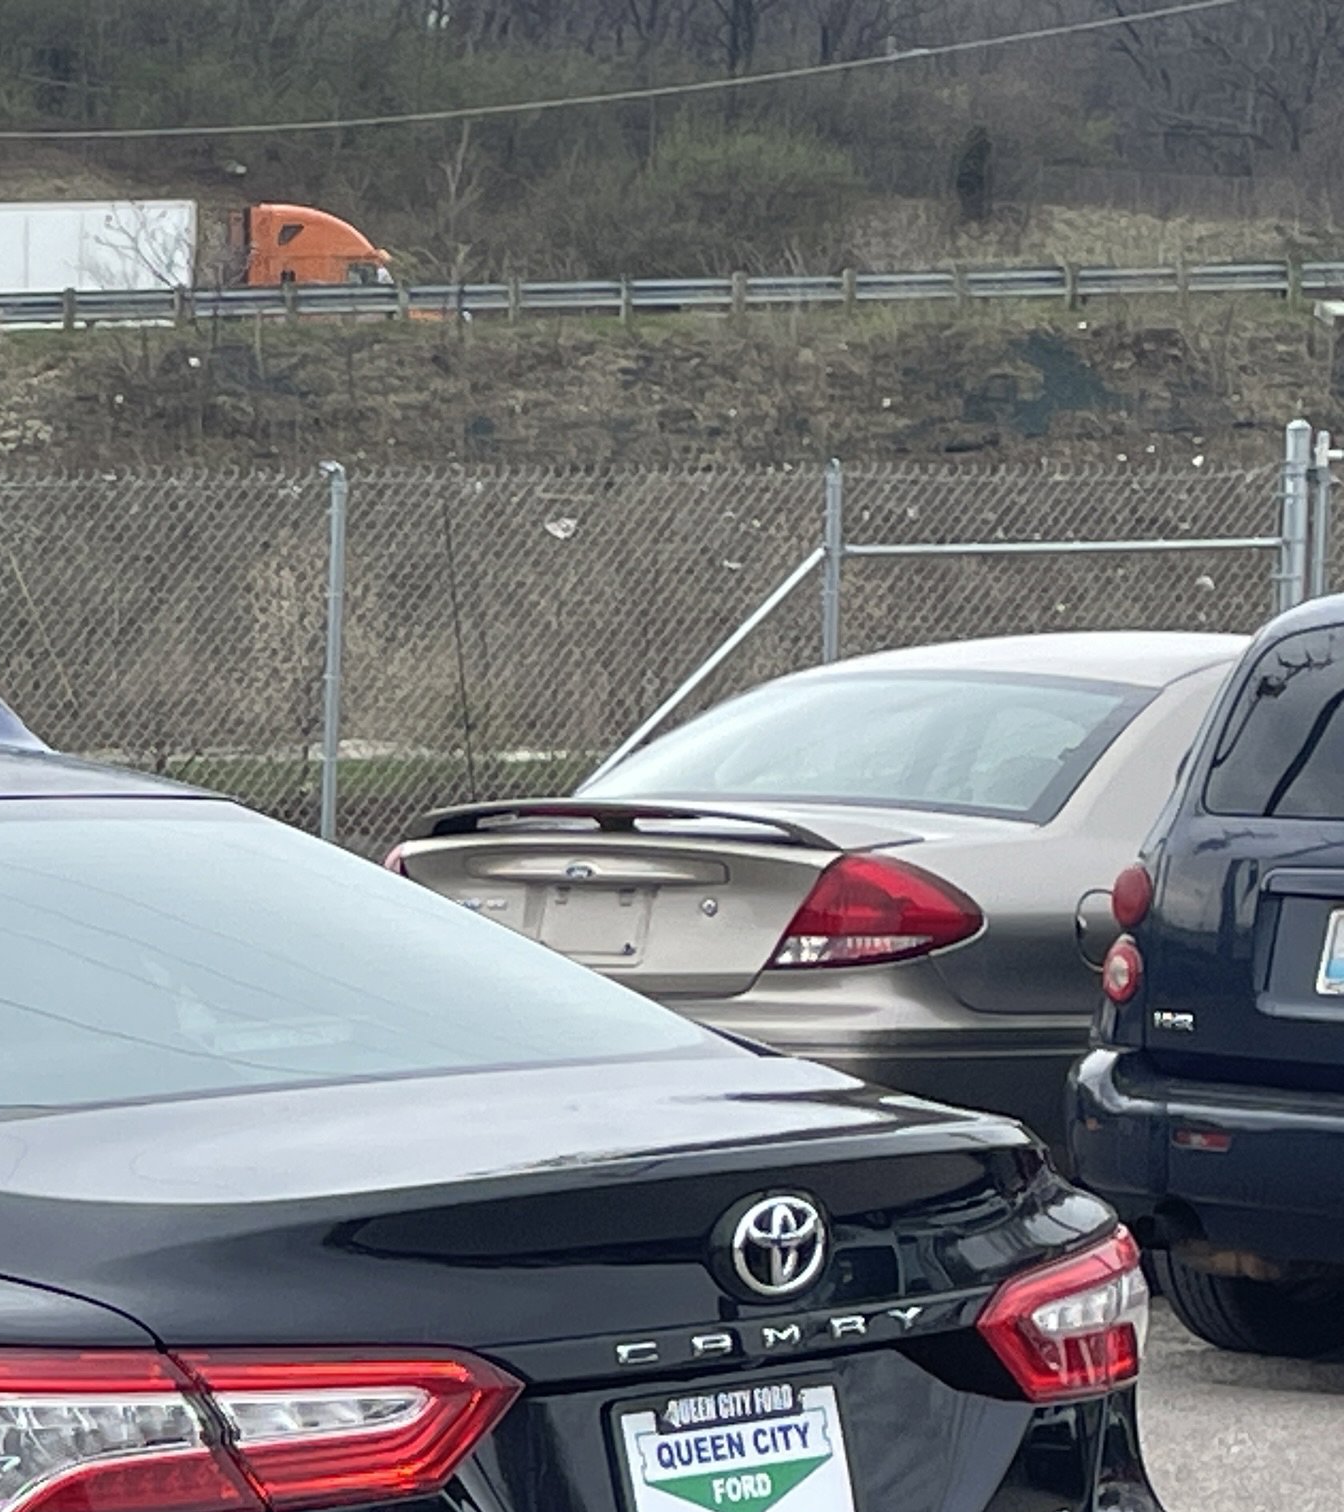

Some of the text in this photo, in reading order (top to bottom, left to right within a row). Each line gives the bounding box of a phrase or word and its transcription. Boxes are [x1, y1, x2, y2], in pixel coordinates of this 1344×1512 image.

[616, 1306, 922, 1364] CAMRY
[666, 1384, 793, 1428] QUEEN CITY FORD
[656, 1422, 811, 1471] QUEEN CITY
[712, 1472, 772, 1505] FORD
